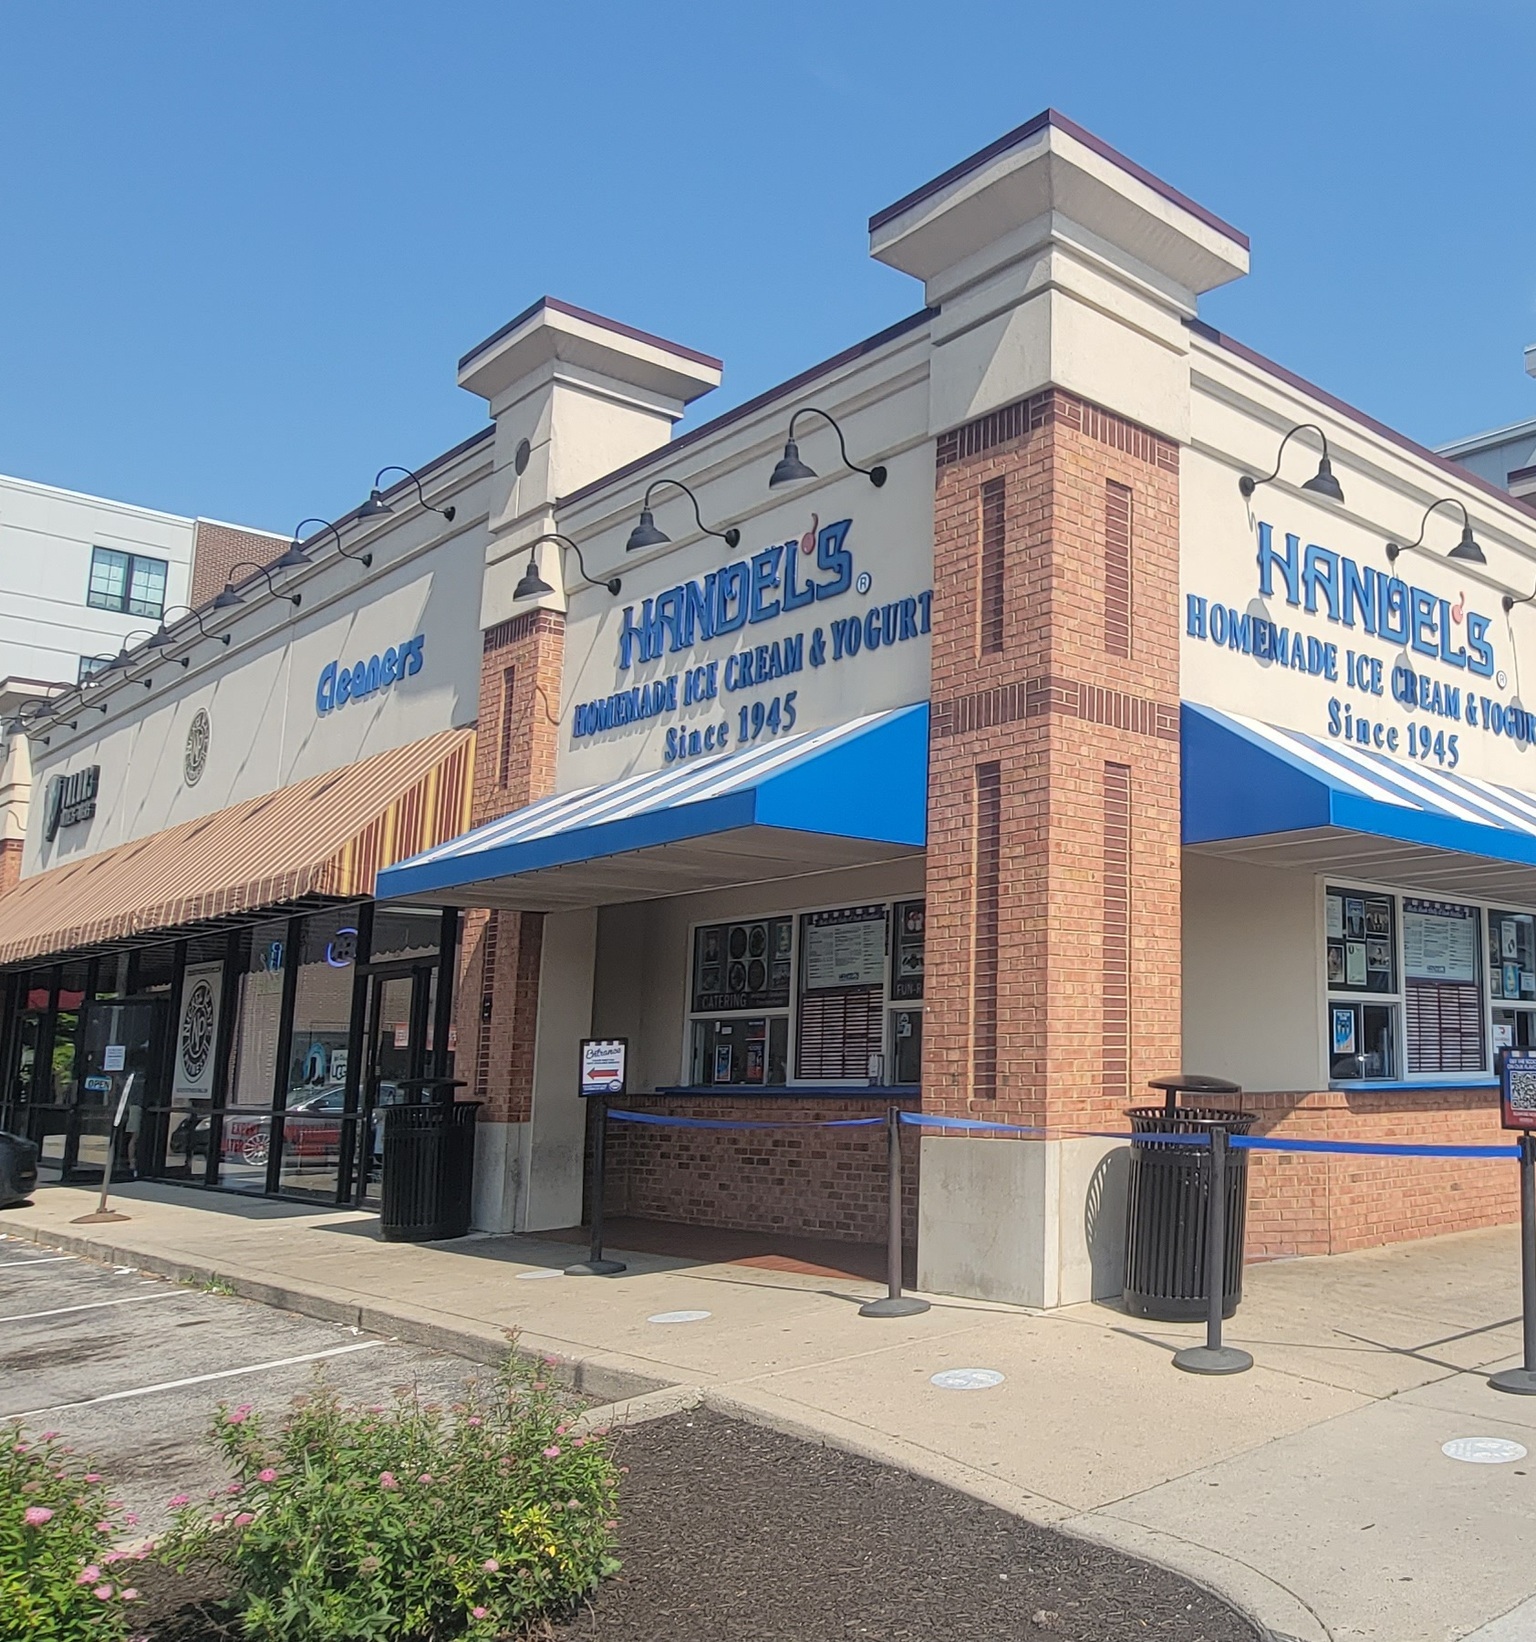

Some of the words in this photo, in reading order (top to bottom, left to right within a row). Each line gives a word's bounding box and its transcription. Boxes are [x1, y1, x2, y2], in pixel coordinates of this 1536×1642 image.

[619, 513, 853, 670] HANDEL'S
[1256, 521, 1495, 679] HANDEL'S
[316, 634, 425, 712] Cleaners
[572, 673, 678, 738] HOMEMADE
[683, 659, 718, 706] ICE
[724, 633, 804, 691] CREAM
[808, 627, 826, 667] &
[830, 589, 934, 661] YOGURT
[1186, 593, 1338, 681] HOMEMADE
[1346, 649, 1384, 697] ICE
[1391, 664, 1460, 721] CREAM
[1465, 692, 1478, 726] &
[664, 719, 730, 762] Since
[738, 690, 797, 742] 1945
[1327, 697, 1400, 750] Since
[1407, 722, 1460, 768] 1945
[702, 993, 747, 1008] CATERING
[88, 1079, 109, 1089] OPEN
